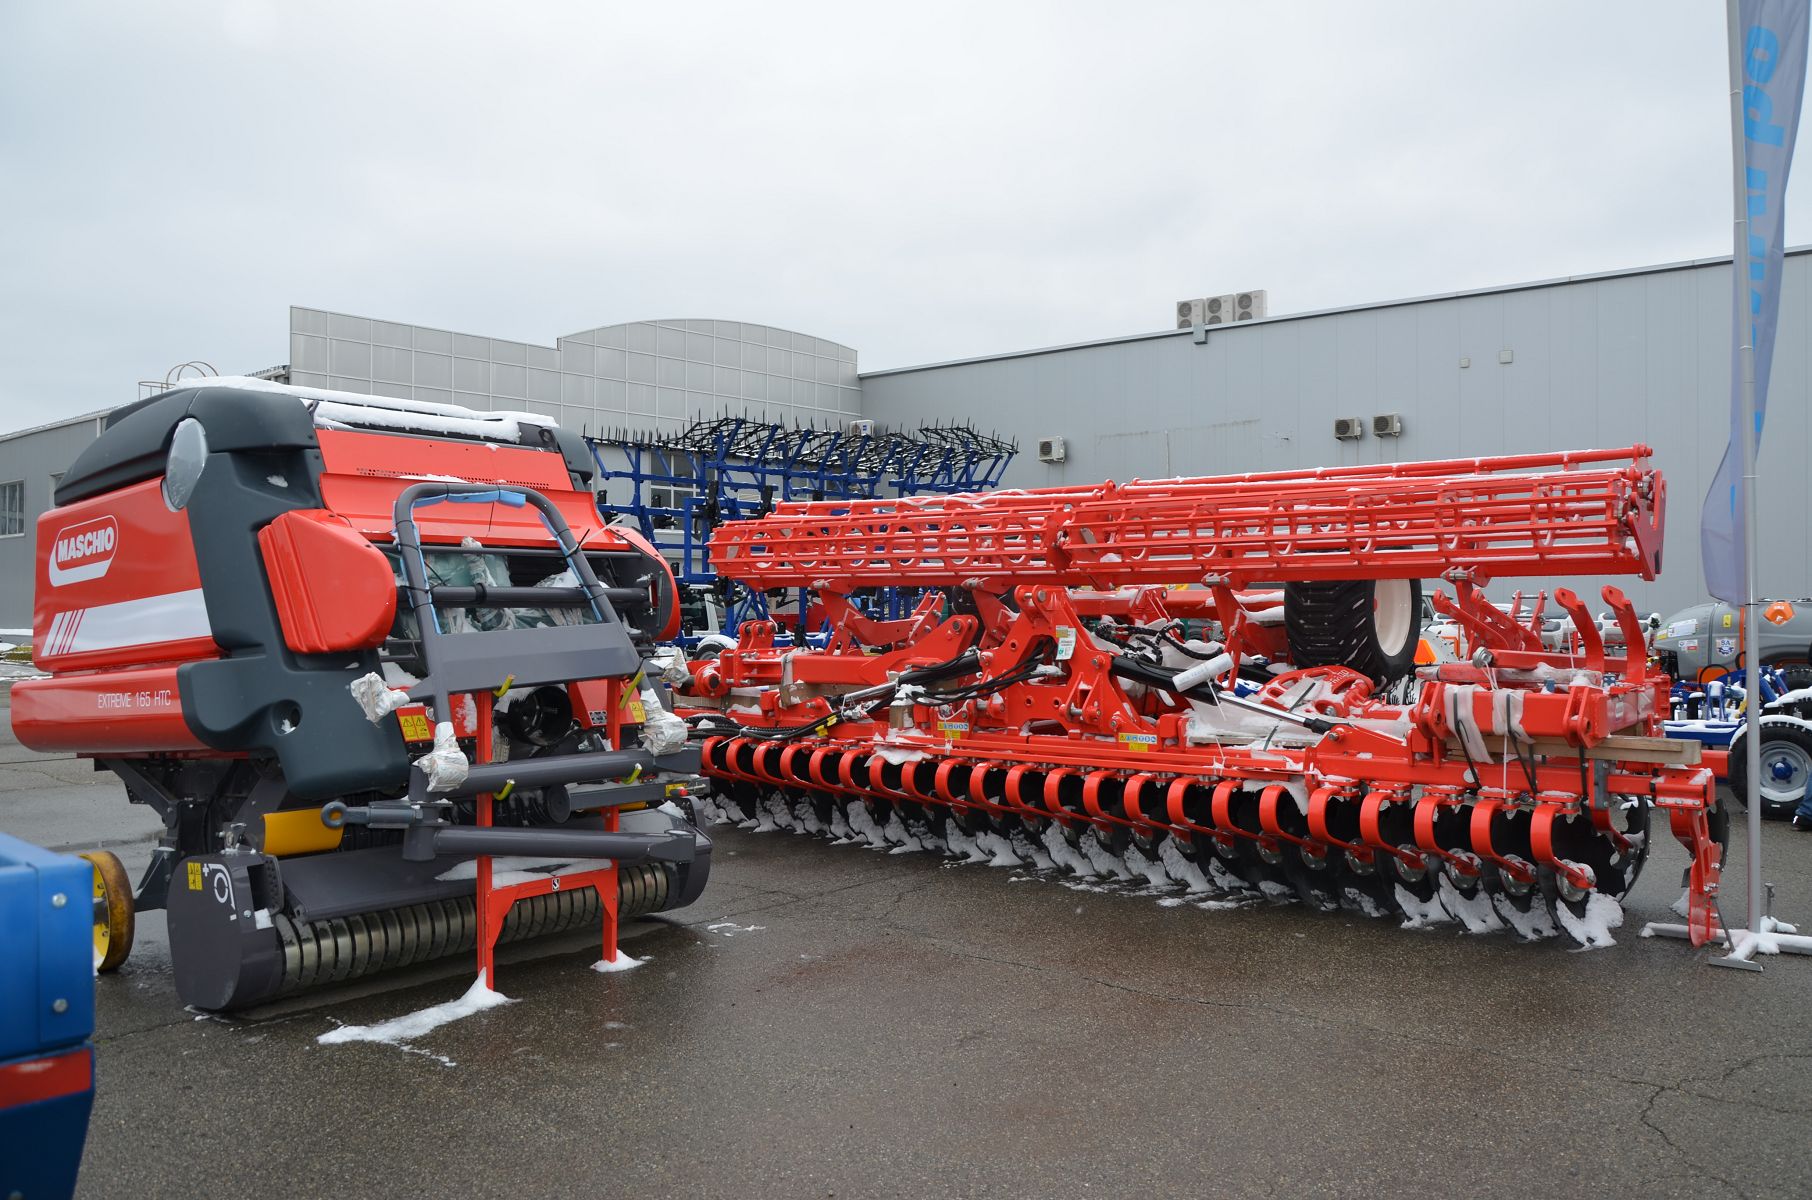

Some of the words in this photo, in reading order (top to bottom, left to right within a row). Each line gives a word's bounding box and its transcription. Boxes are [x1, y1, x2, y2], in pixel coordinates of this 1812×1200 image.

[57, 526, 115, 562] MASCHIO
[97, 692, 132, 708] EXTREME
[135, 691, 151, 707] 165
[154, 690, 171, 706] HTC
